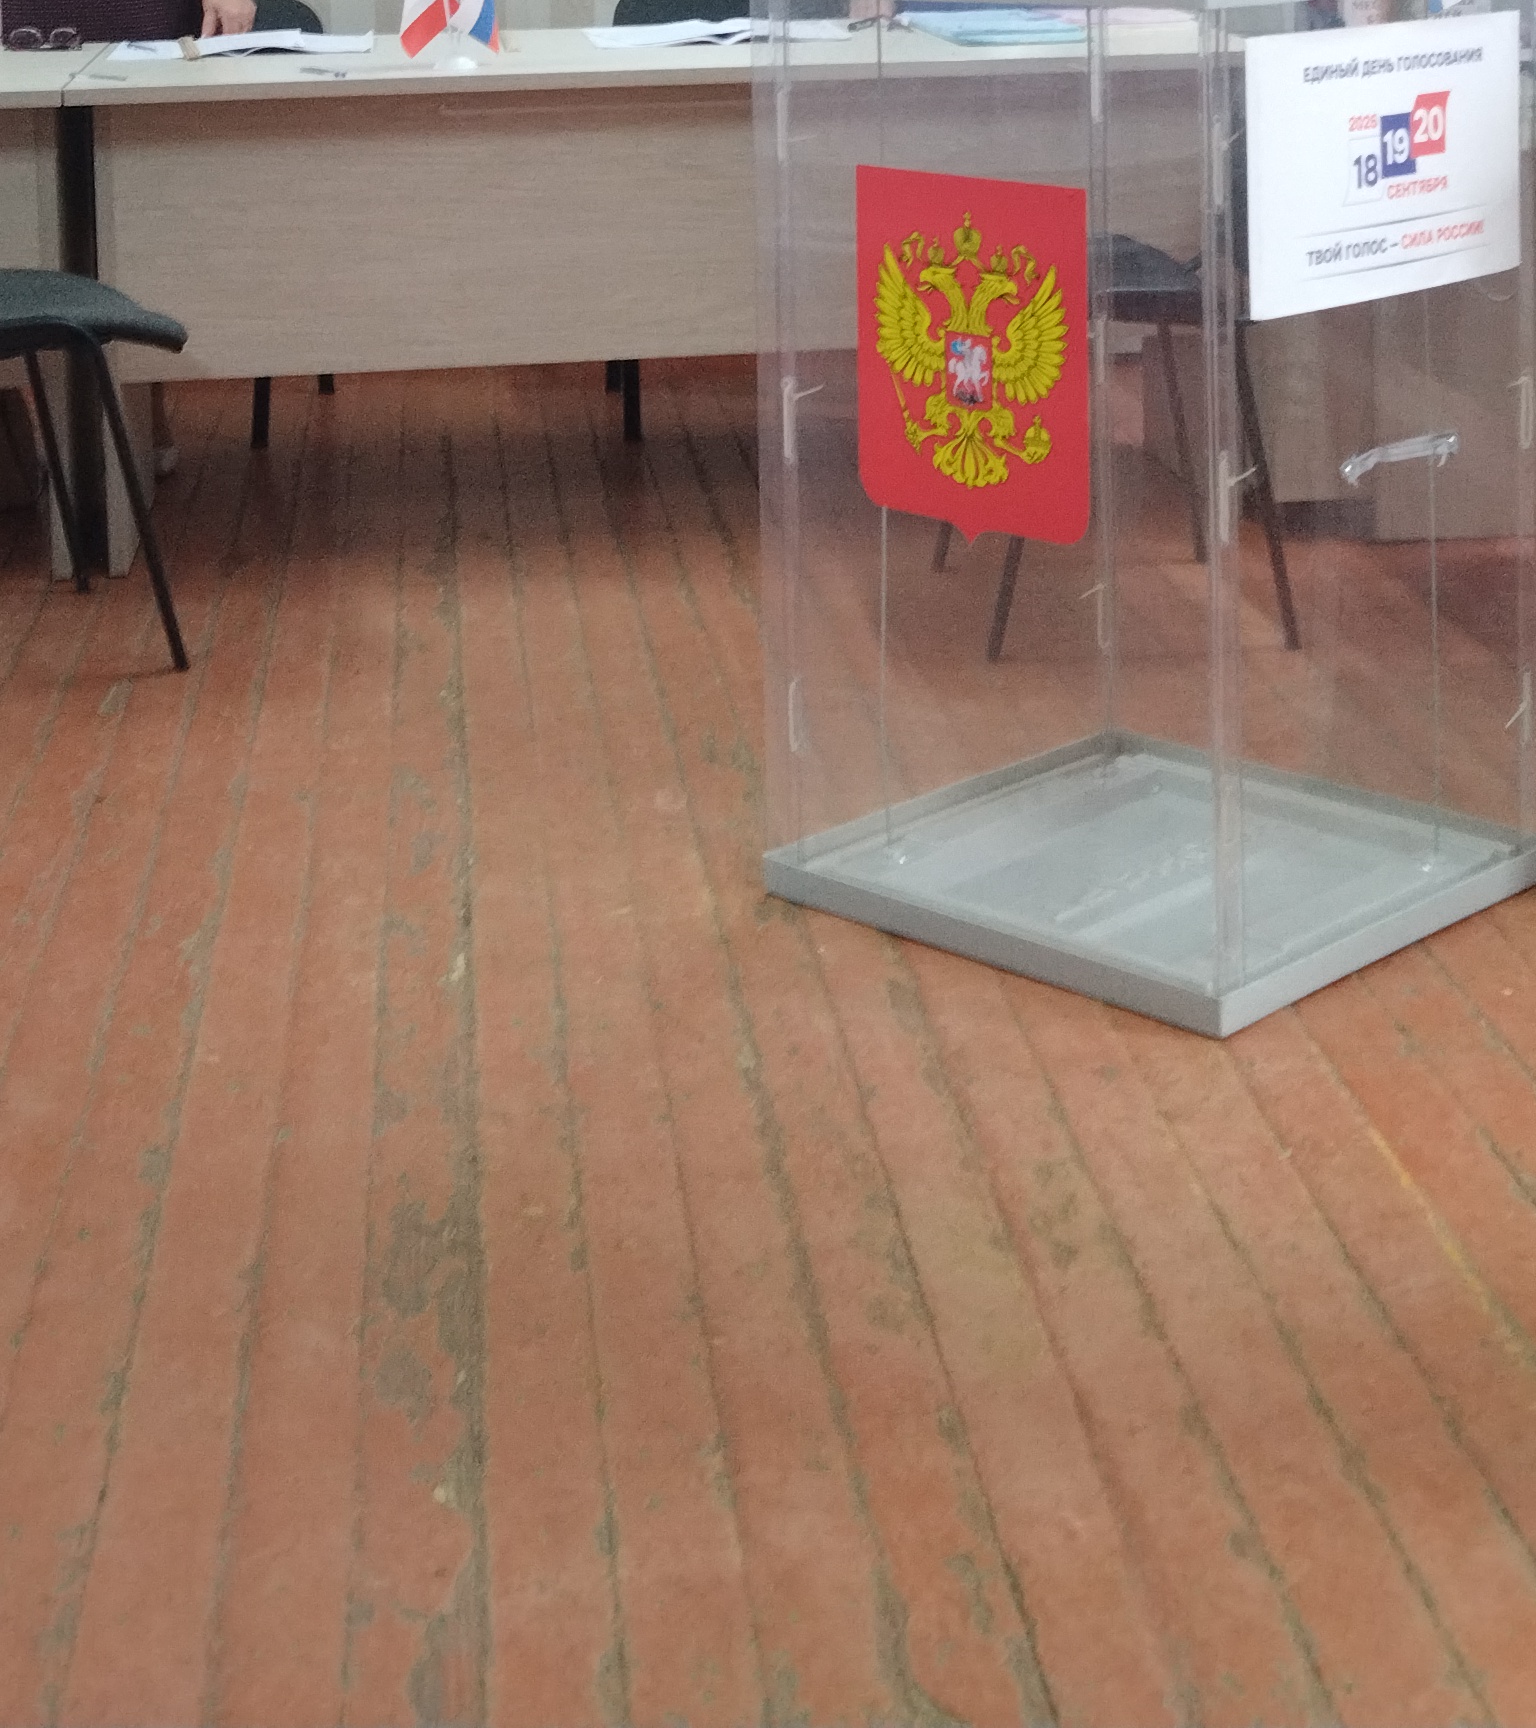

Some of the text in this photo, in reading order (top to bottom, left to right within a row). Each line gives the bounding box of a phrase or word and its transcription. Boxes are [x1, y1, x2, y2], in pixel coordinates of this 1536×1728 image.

[1303, 47, 1483, 84] ЕДИНЫЙ ДЕНЬ ГОЛОСОВАНИЯ
[1353, 106, 1444, 189] 18 19 20
[1387, 175, 1448, 200] СЕНТЯБРЯ
[1306, 240, 1342, 267] ТВОЙ
[1344, 238, 1388, 260] ГОЛОС
[1400, 231, 1433, 249] СИЛА
